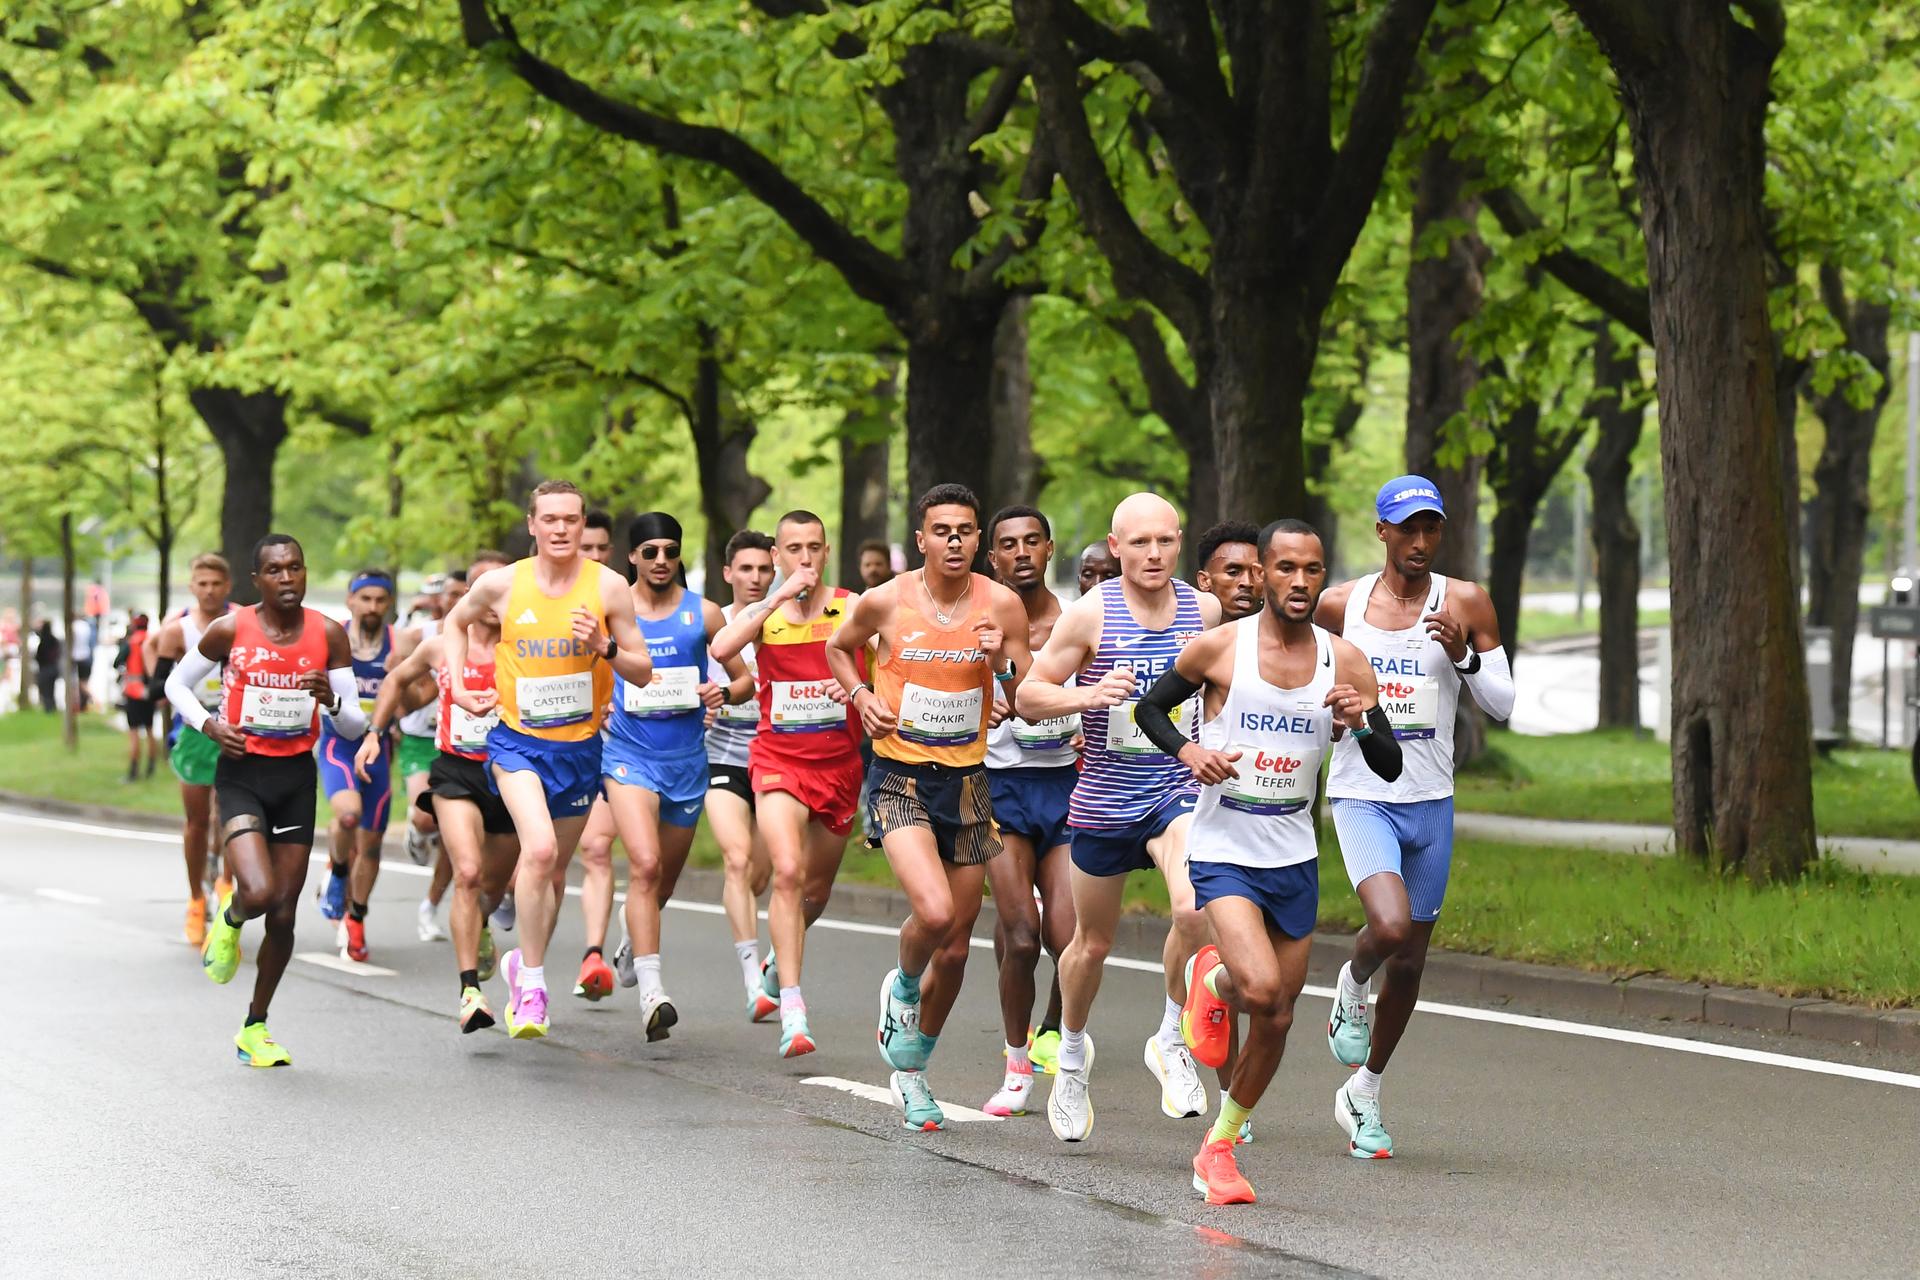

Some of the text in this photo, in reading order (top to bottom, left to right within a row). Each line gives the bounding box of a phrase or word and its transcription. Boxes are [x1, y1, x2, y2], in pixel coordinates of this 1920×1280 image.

[1394, 488, 1438, 502] ISRAEL
[649, 645, 678, 657] ALIA
[1371, 656, 1426, 676] RAEL
[789, 685, 823, 699] Lott
[1377, 682, 1415, 699] otto
[533, 695, 579, 707] CASTEEL
[782, 701, 835, 712] IVANOVSKI
[924, 695, 979, 709] NOVARTIS
[1384, 702, 1416, 714] AME
[922, 712, 965, 723] CHAKIR
[1240, 712, 1315, 734] ISRAEL
[1254, 775, 1296, 789] TEFERI
